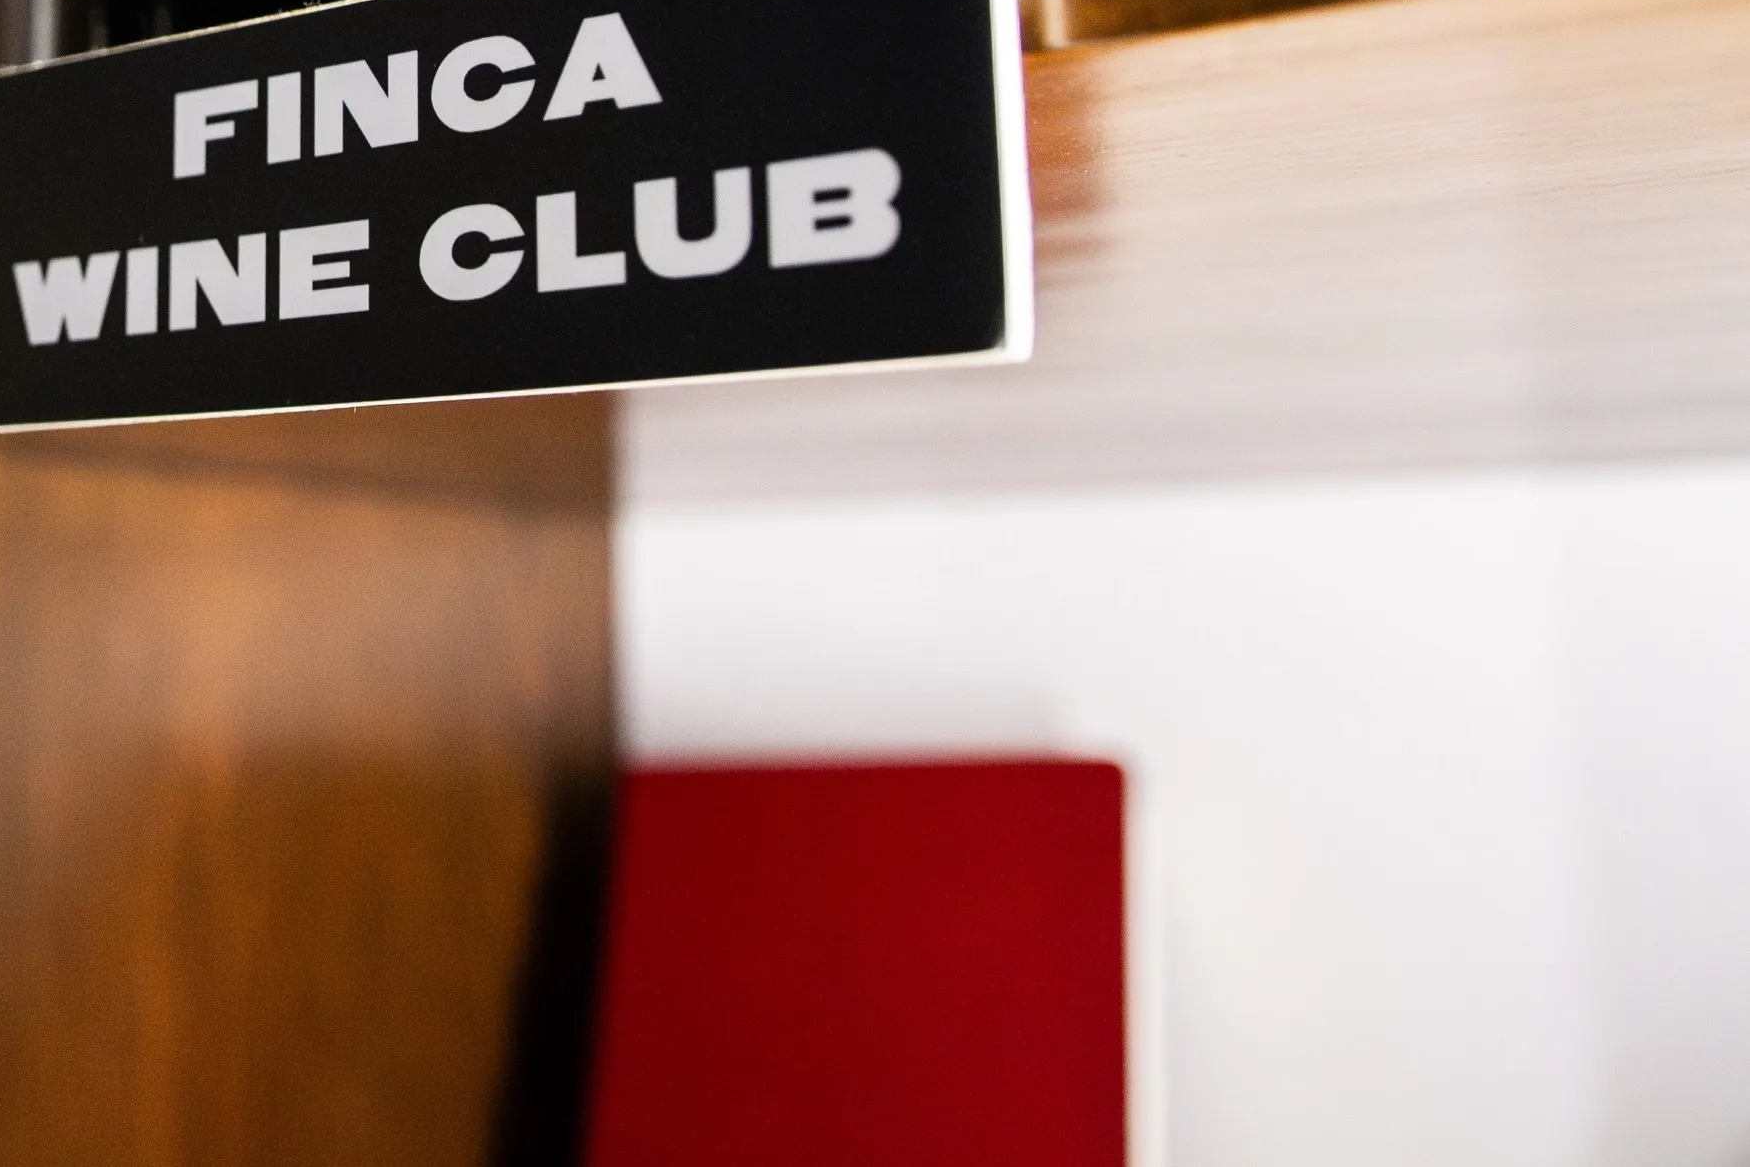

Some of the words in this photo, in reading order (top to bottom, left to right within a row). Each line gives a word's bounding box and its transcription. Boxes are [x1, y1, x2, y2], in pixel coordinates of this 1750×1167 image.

[172, 11, 662, 179] FINCA
[13, 218, 370, 345] WINE
[419, 146, 902, 301] CLUB
